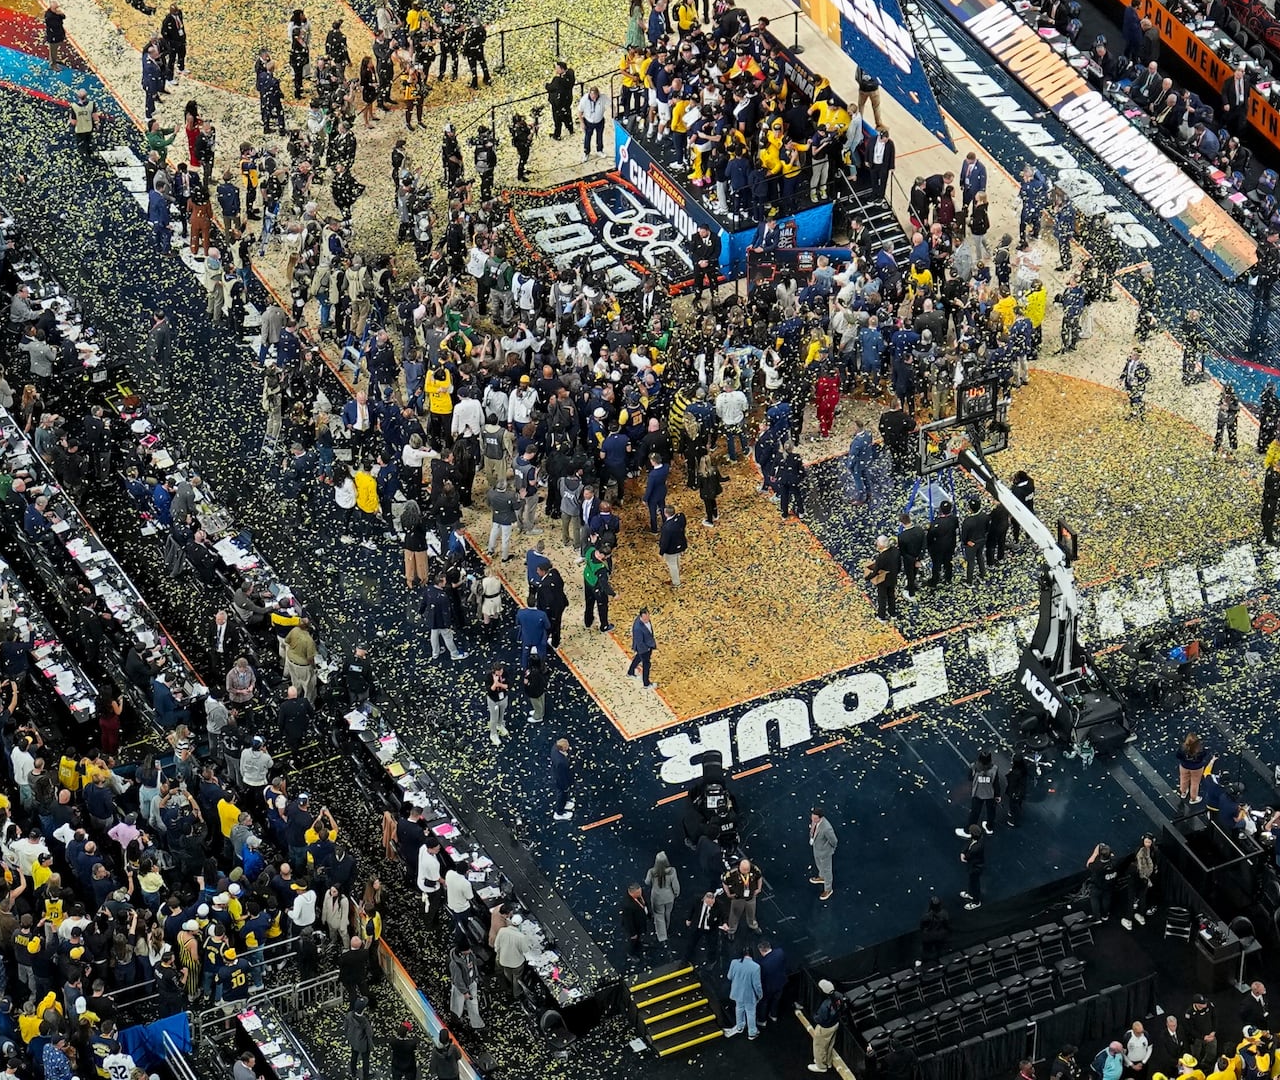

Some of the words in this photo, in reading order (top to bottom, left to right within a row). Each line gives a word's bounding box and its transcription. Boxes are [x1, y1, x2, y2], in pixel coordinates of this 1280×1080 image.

[784, 61, 815, 100] FINA
[1185, 35, 1226, 84] MEN'
[964, 0, 1088, 104] NATIONAL
[1058, 90, 1205, 219] CHAMPIONS
[652, 170, 686, 207] NATIONAL
[658, 646, 948, 784] FOUR
[1021, 668, 1062, 718] NCAA
[231, 976, 246, 987] 10
[111, 1065, 128, 1079] 32
